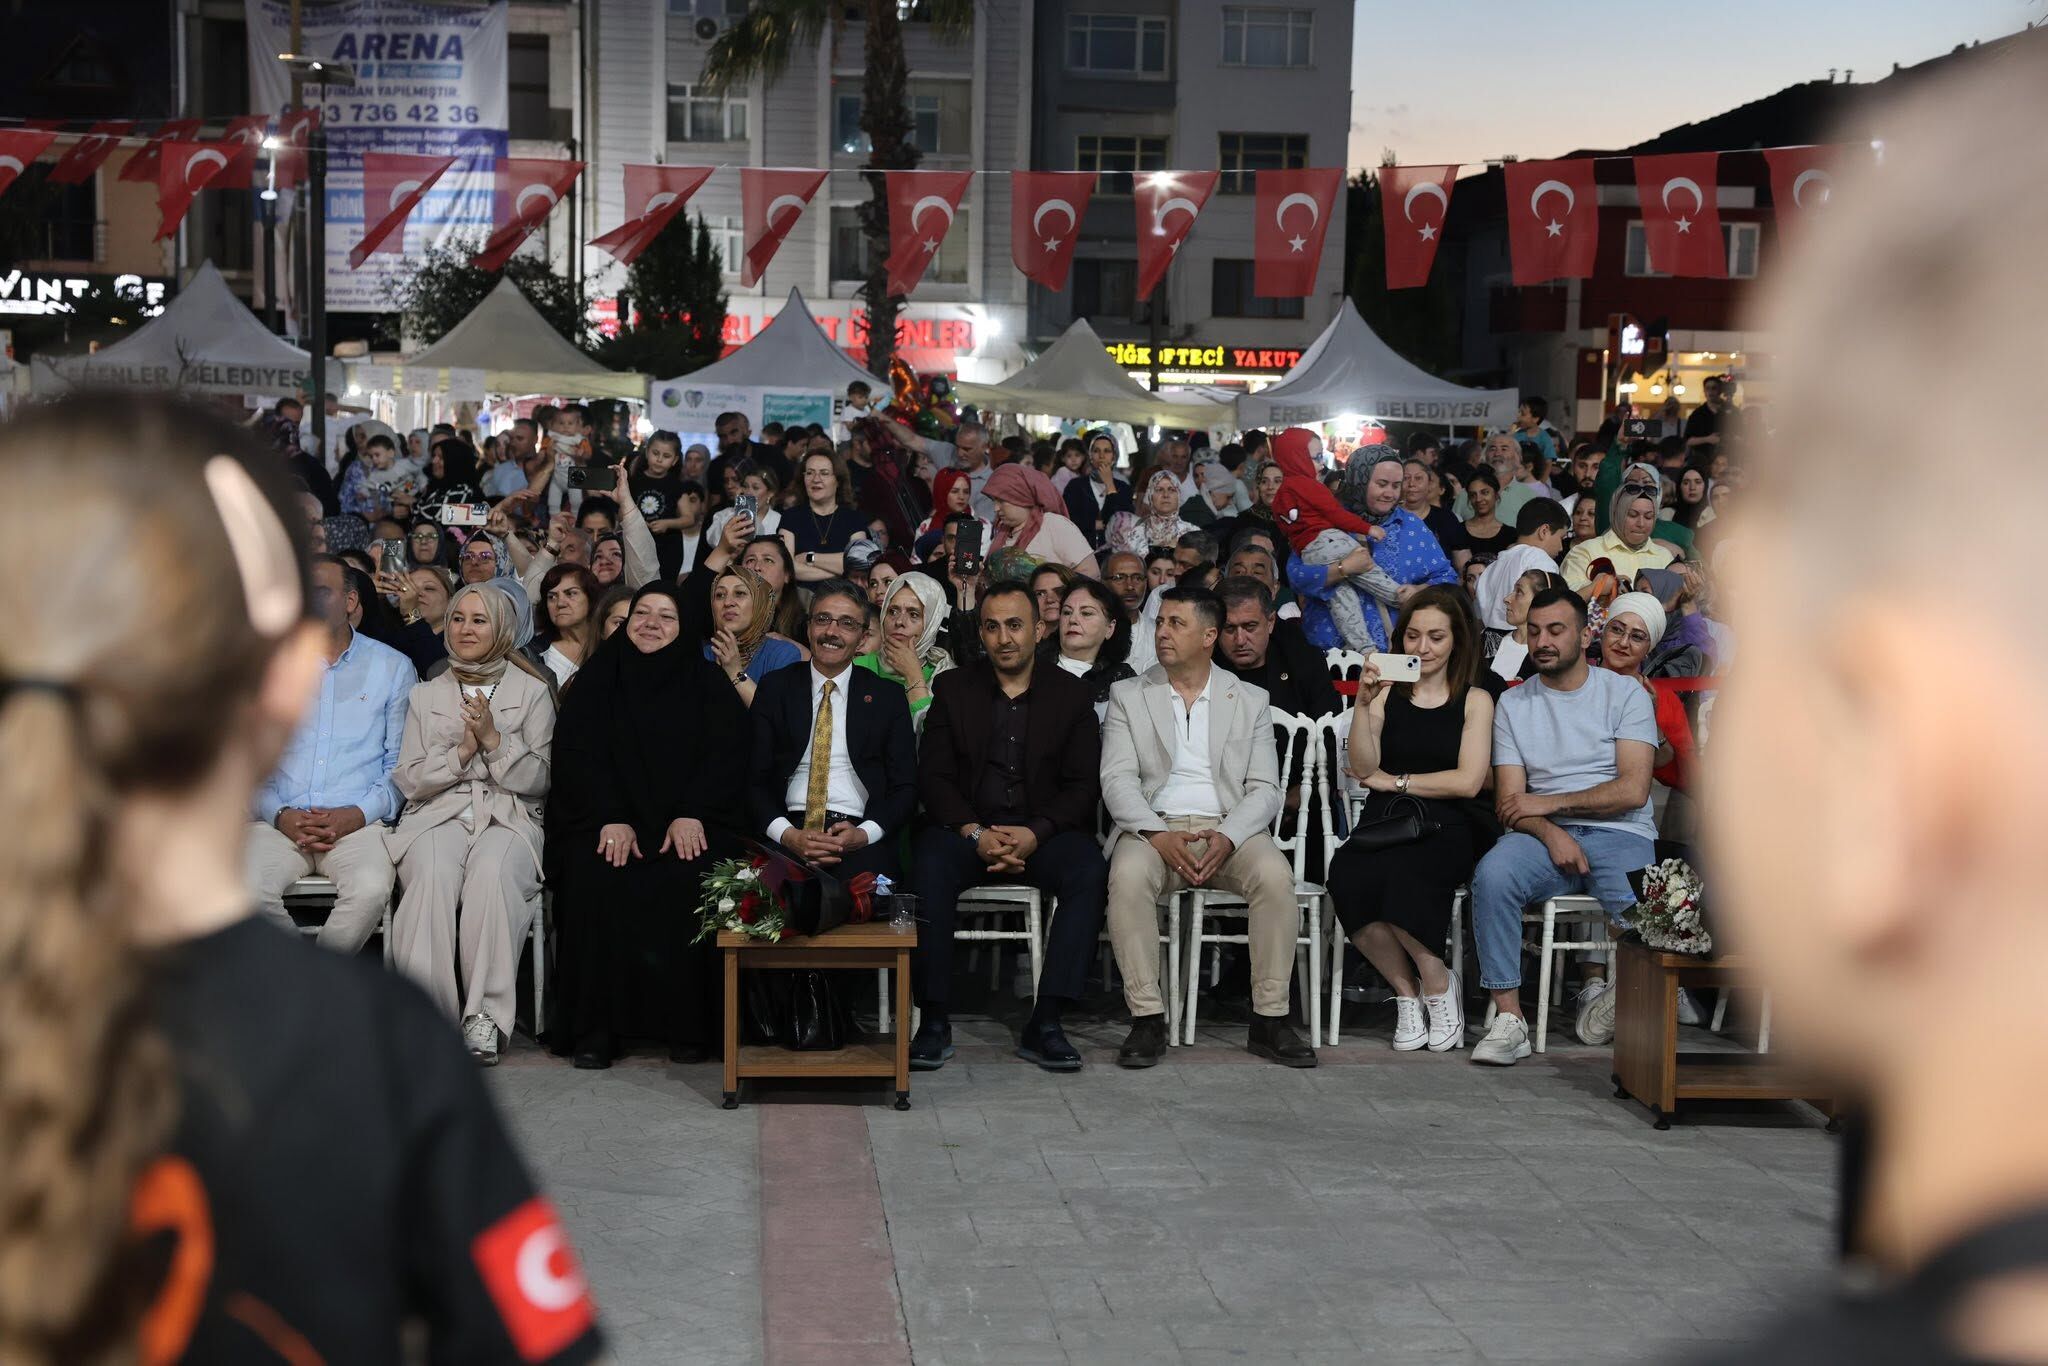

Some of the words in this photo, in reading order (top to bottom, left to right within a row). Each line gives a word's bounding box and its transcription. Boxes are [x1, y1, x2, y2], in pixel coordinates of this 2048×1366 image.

[332, 33, 464, 60] ARENA
[303, 86, 374, 97] ARFINDAN
[350, 104, 397, 121] 736
[407, 105, 439, 122] 42
[448, 106, 479, 123] 36
[846, 309, 977, 349] ÜNLER
[1106, 344, 1224, 366] İĞKFTECİ
[1233, 350, 1300, 368] YAKUT
[188, 366, 312, 388] BELEDİYES
[1376, 400, 1491, 419] BELEDİYESİ
